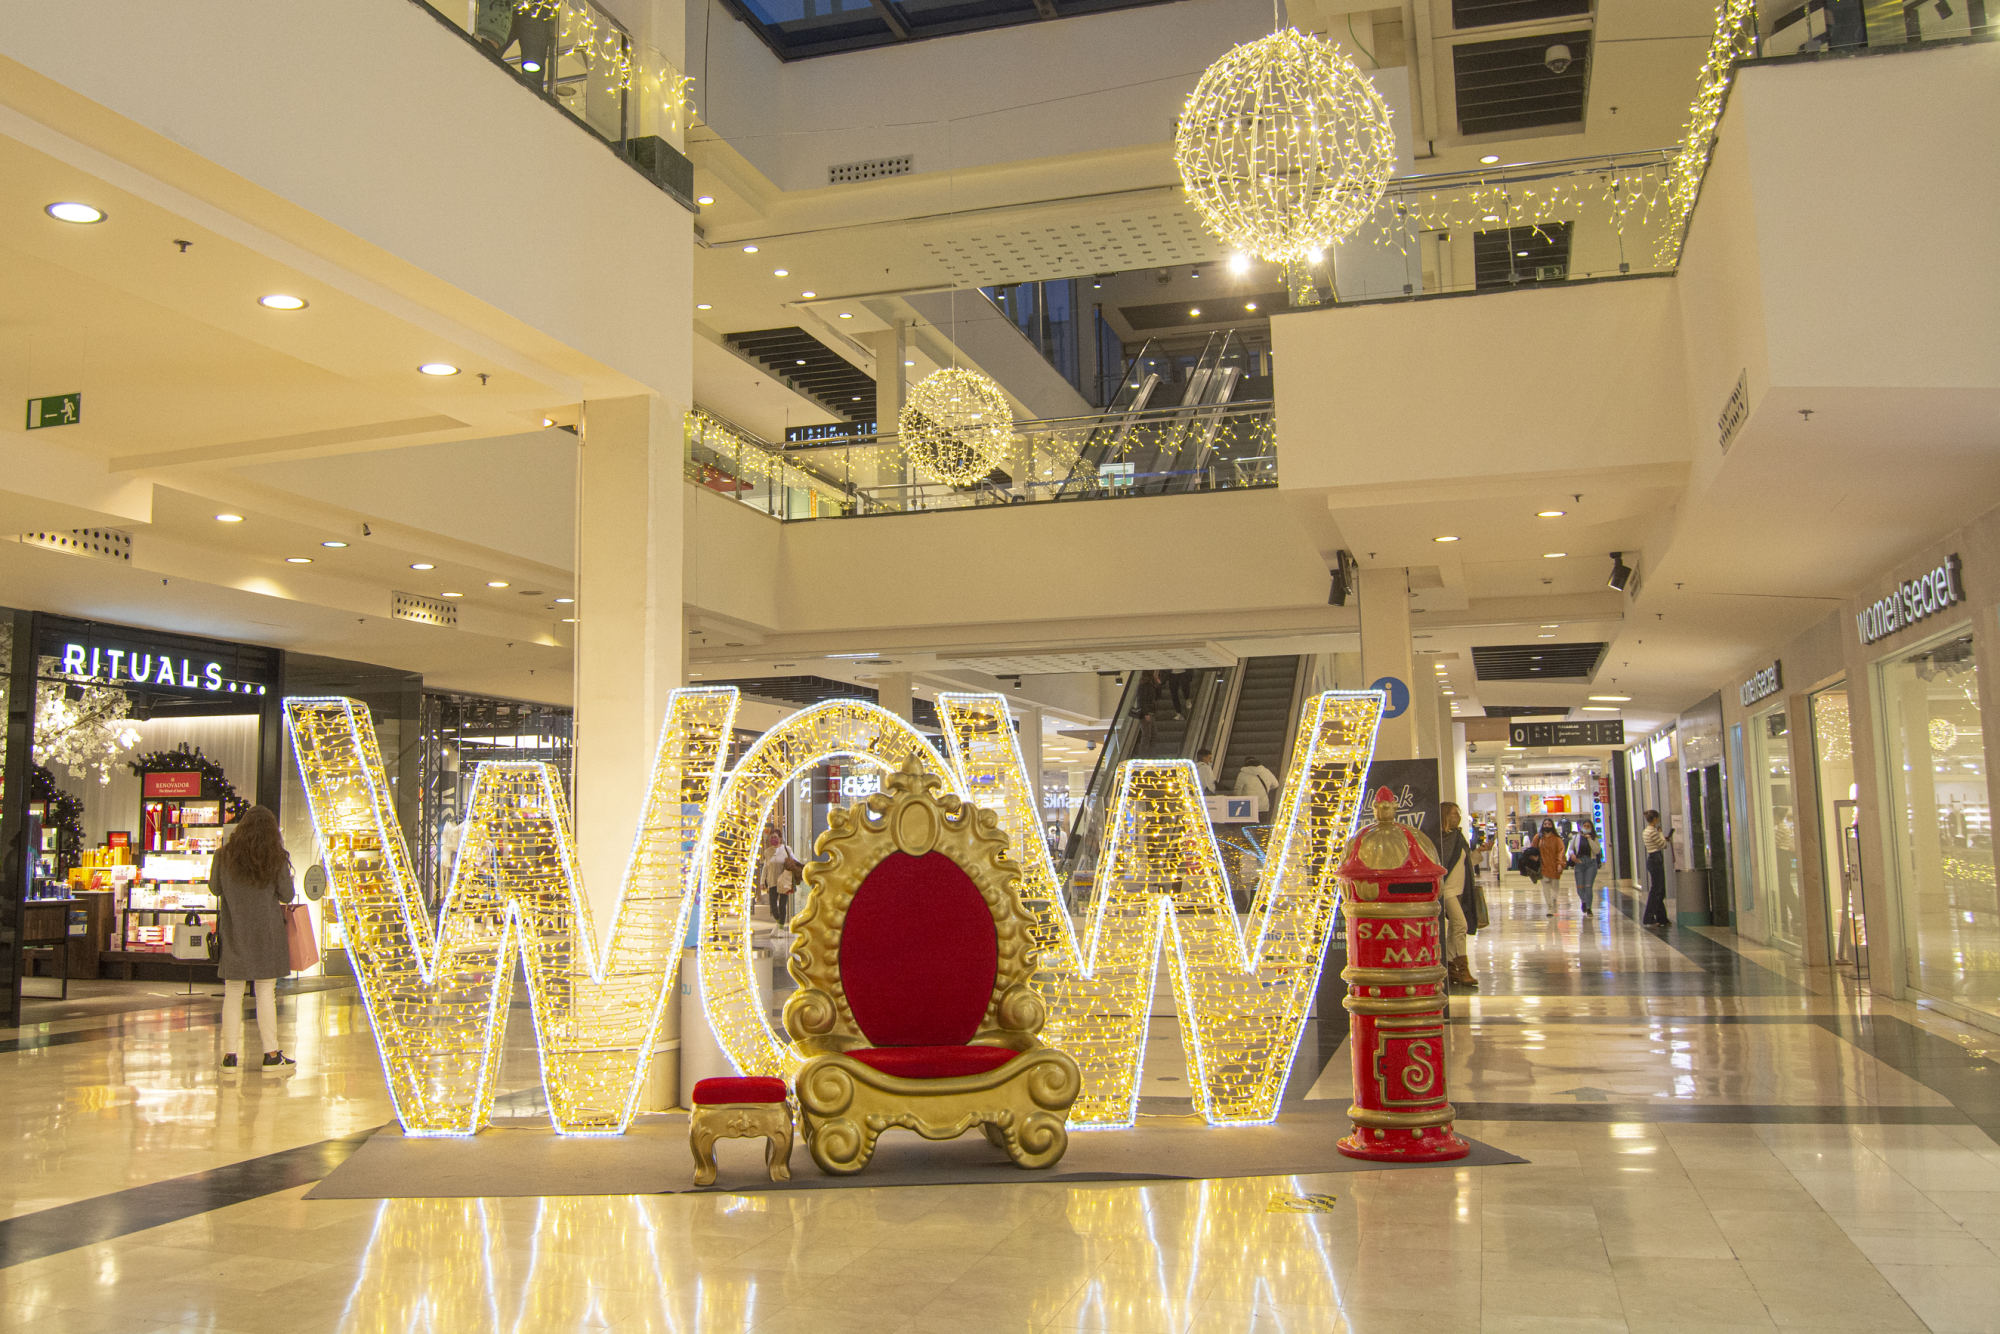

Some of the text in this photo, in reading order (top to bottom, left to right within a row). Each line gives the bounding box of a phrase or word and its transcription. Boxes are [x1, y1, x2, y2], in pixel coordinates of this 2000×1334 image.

[1856, 554, 1960, 645] women'secret
[1514, 728, 1525, 742] 0
[1358, 920, 1438, 940] SANT
[1382, 943, 1441, 963] MAI
